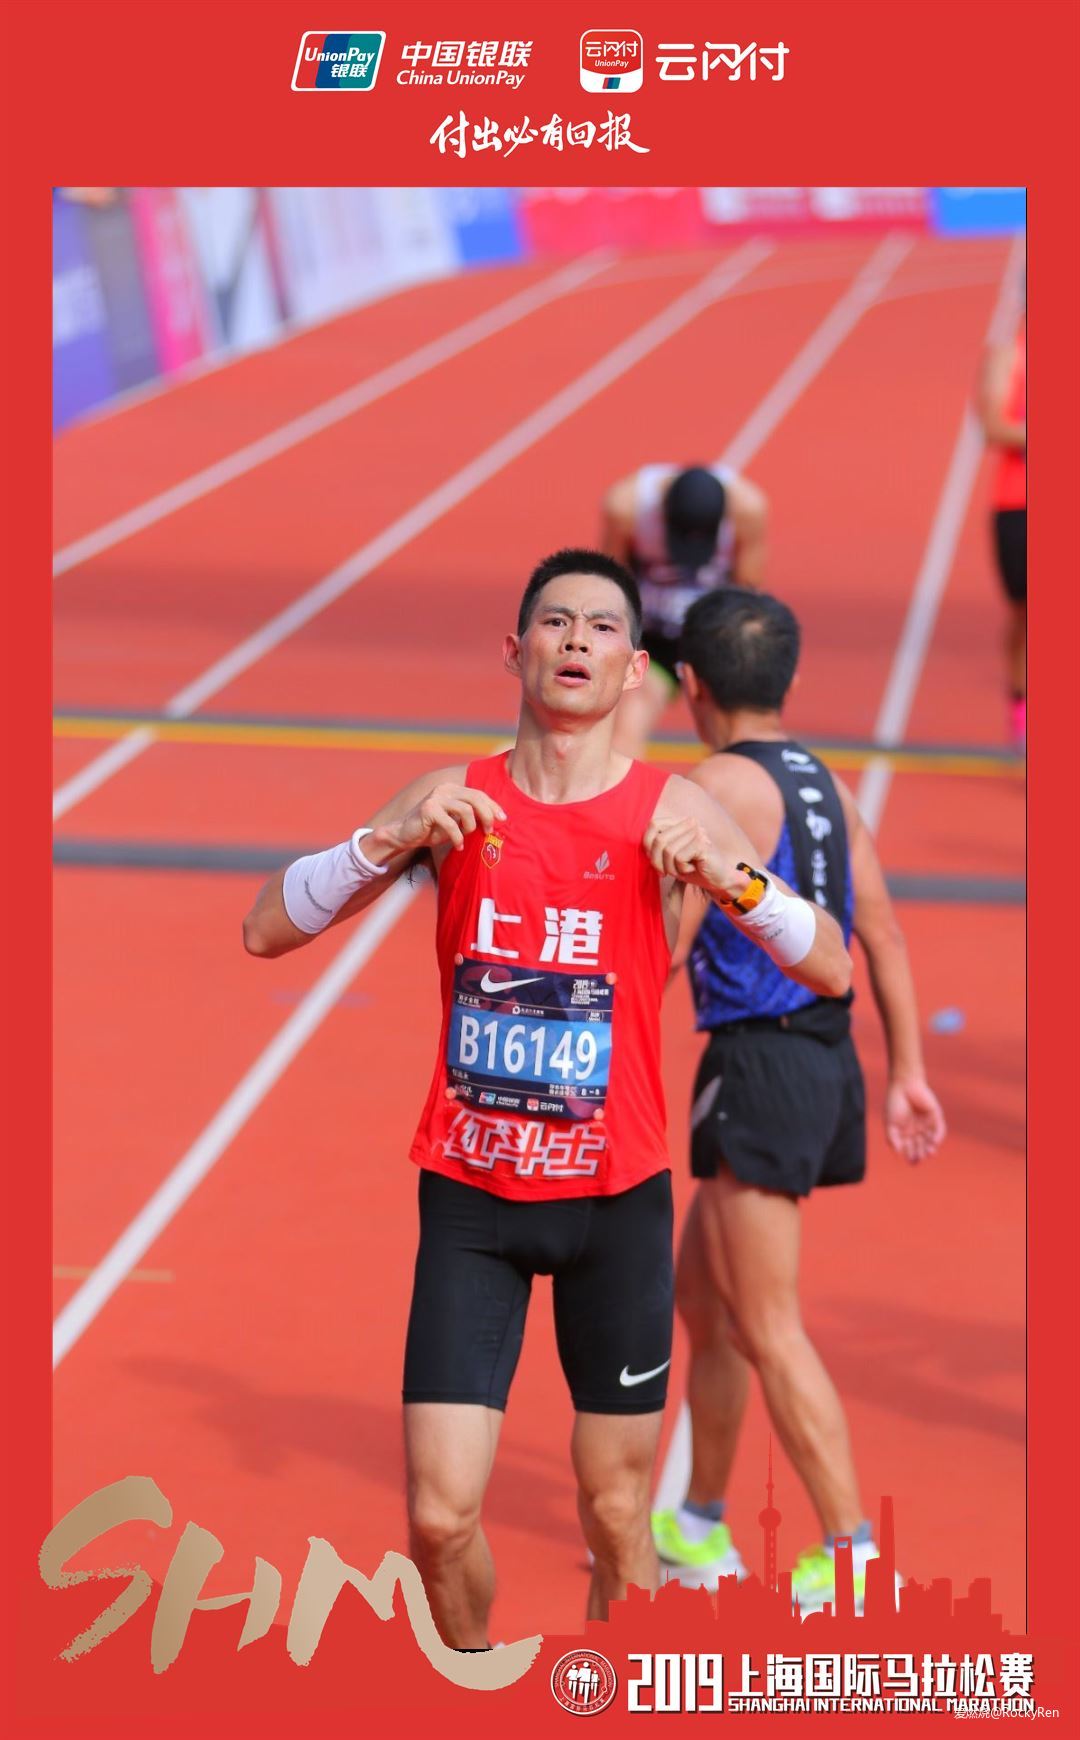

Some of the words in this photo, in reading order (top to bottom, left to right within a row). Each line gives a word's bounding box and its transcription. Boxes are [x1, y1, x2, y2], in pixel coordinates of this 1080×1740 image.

[458, 1014, 598, 1080] B16149
[444, 1108, 606, 1176] 红斗士
